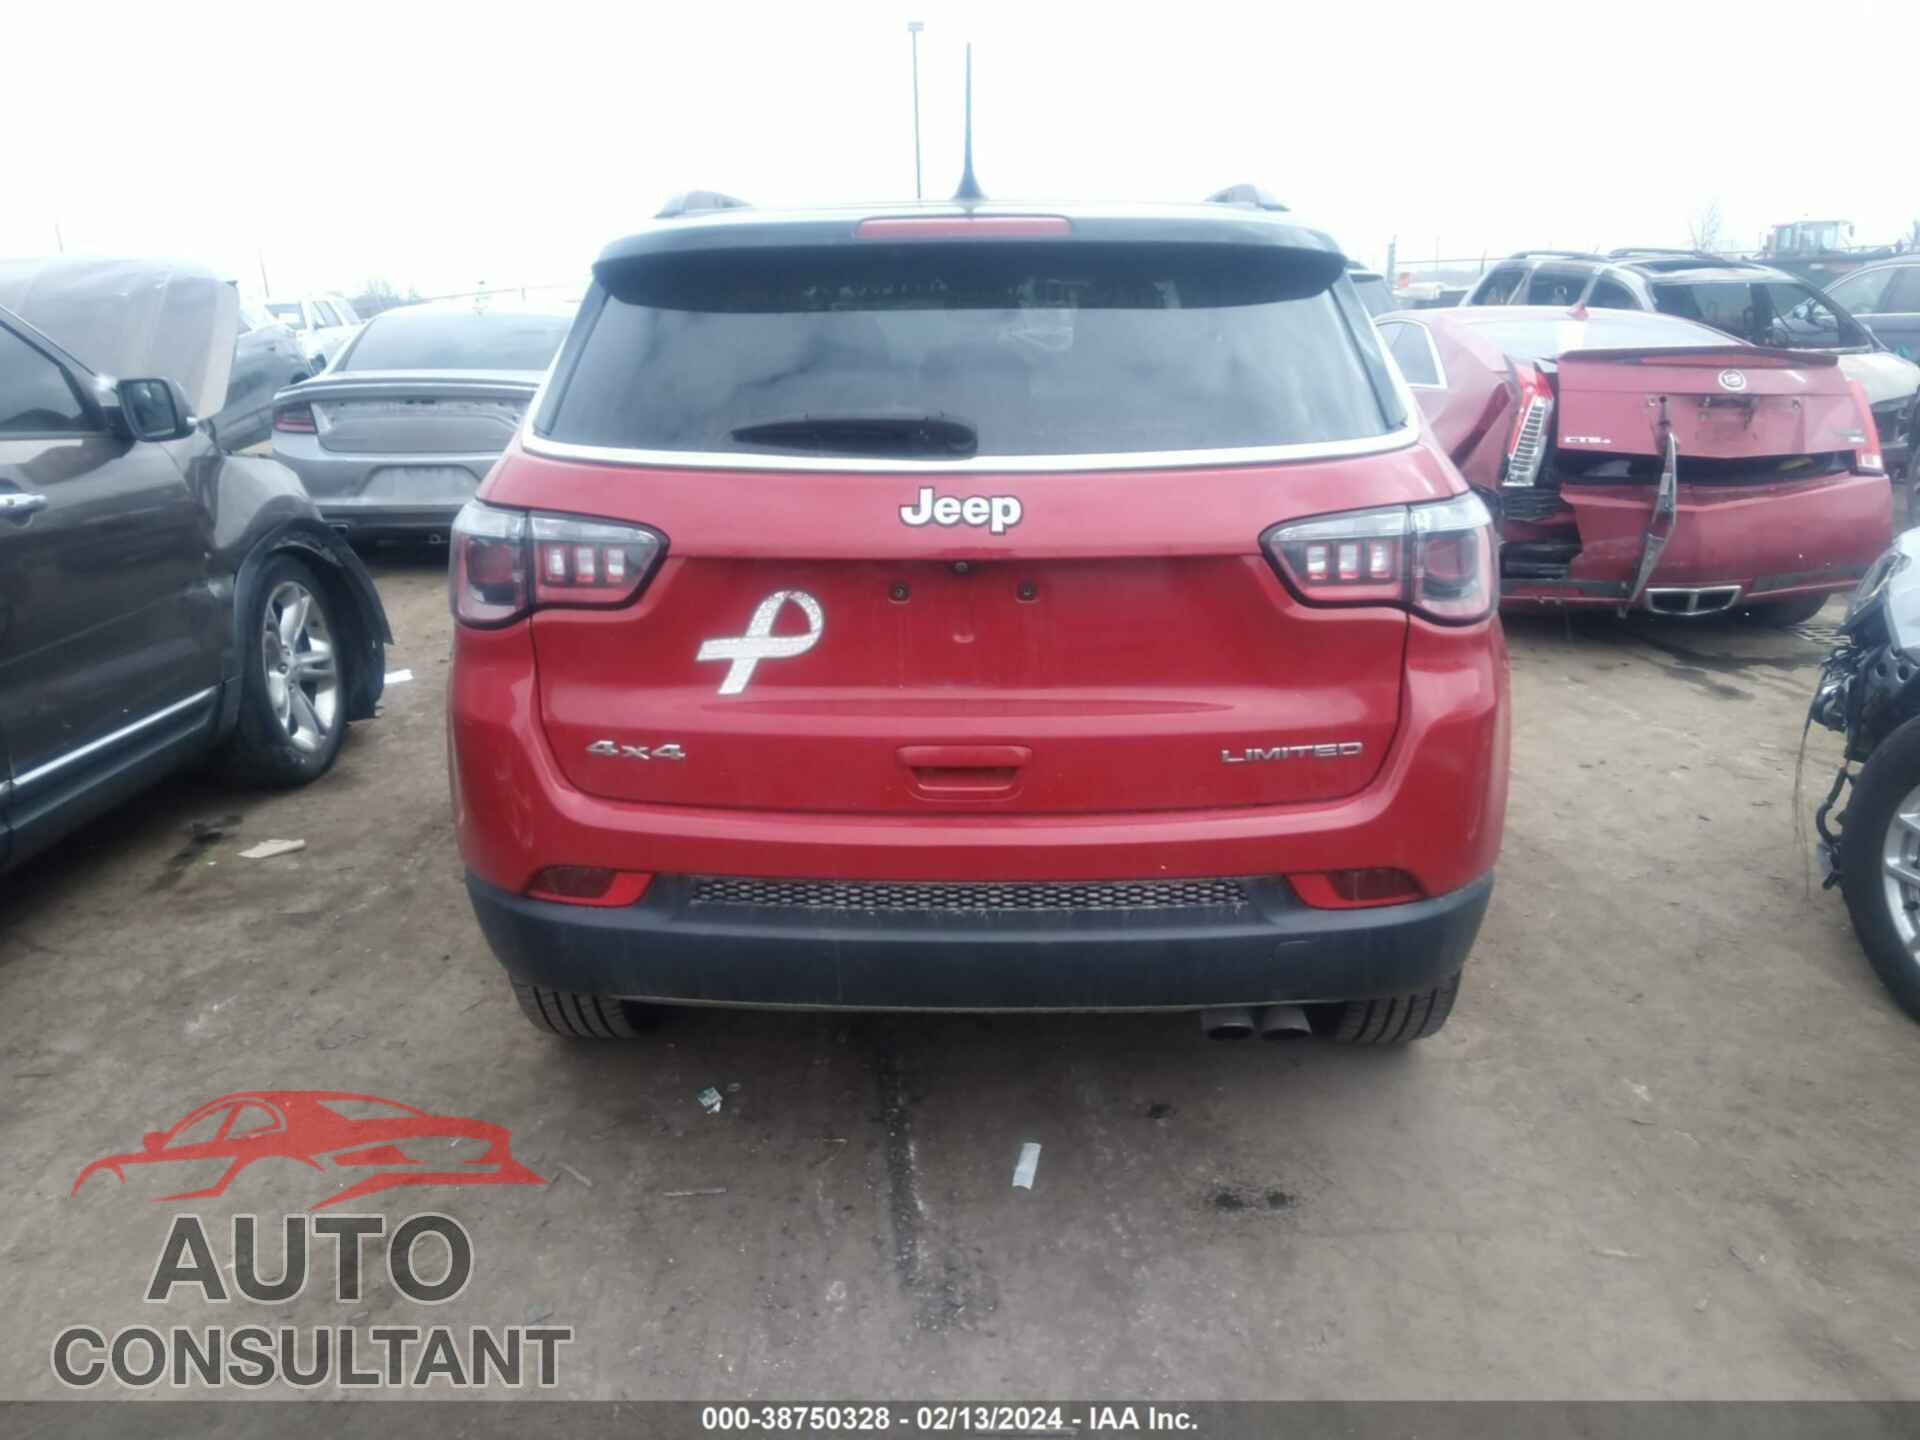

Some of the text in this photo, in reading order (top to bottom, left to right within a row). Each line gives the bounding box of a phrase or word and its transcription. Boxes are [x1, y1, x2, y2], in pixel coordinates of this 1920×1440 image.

[899, 487, 1023, 534] Jeep
[585, 740, 686, 760] 4x4
[1222, 742, 1363, 763] LIMITED
